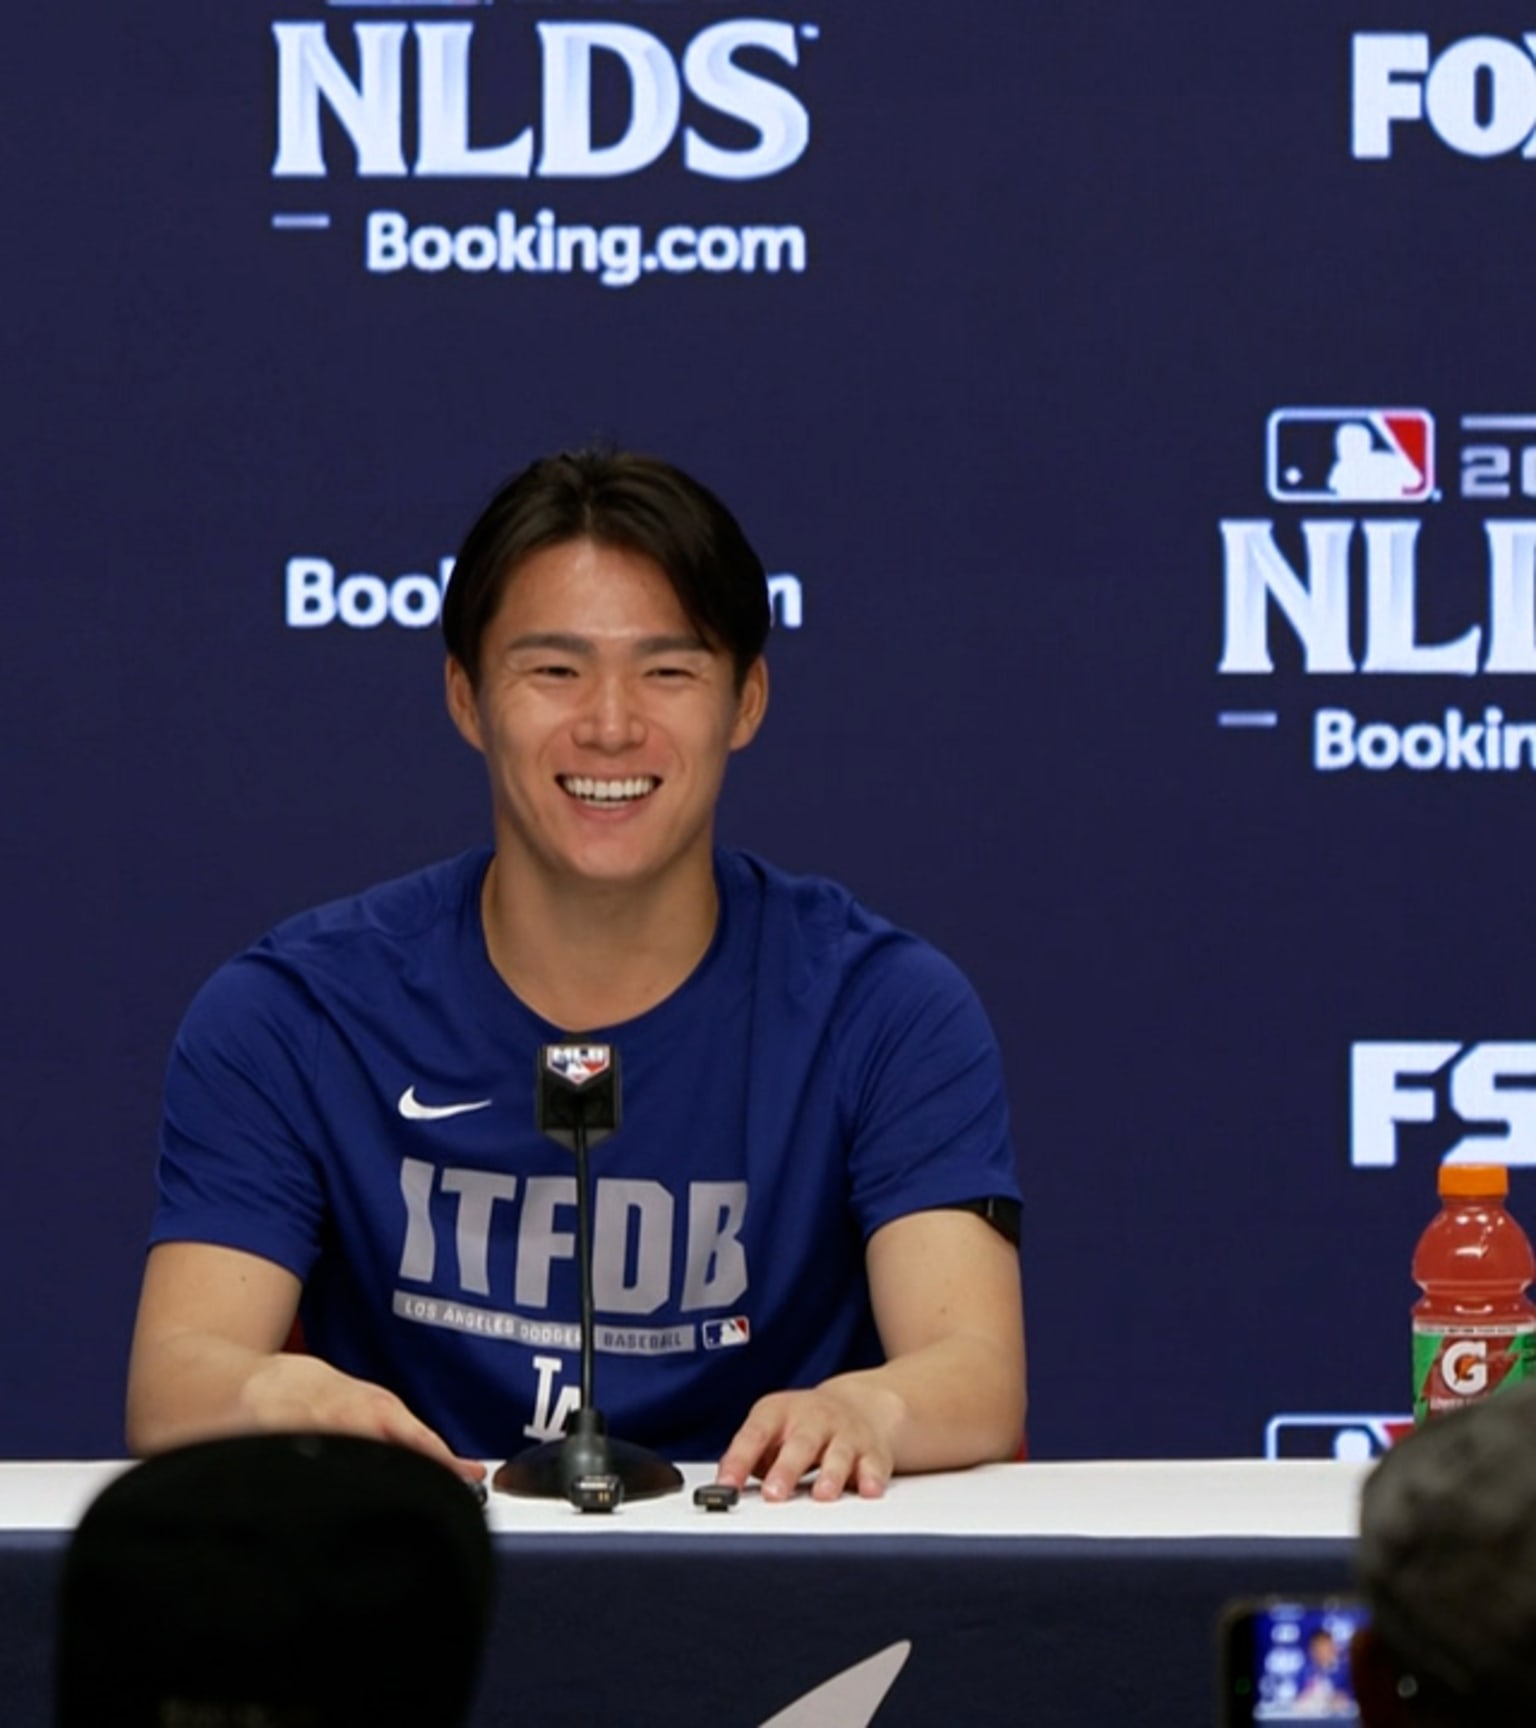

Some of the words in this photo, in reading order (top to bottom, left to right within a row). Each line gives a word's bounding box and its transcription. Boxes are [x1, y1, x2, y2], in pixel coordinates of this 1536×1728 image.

[272, 19, 810, 180] NLDS
[1352, 33, 1536, 158] FO
[366, 208, 806, 287] Booking.com
[398, 1157, 749, 1315] ITFDB
[404, 1299, 438, 1316] LOS
[442, 1306, 514, 1334] ANGELES
[1441, 1340, 1487, 1396] G
